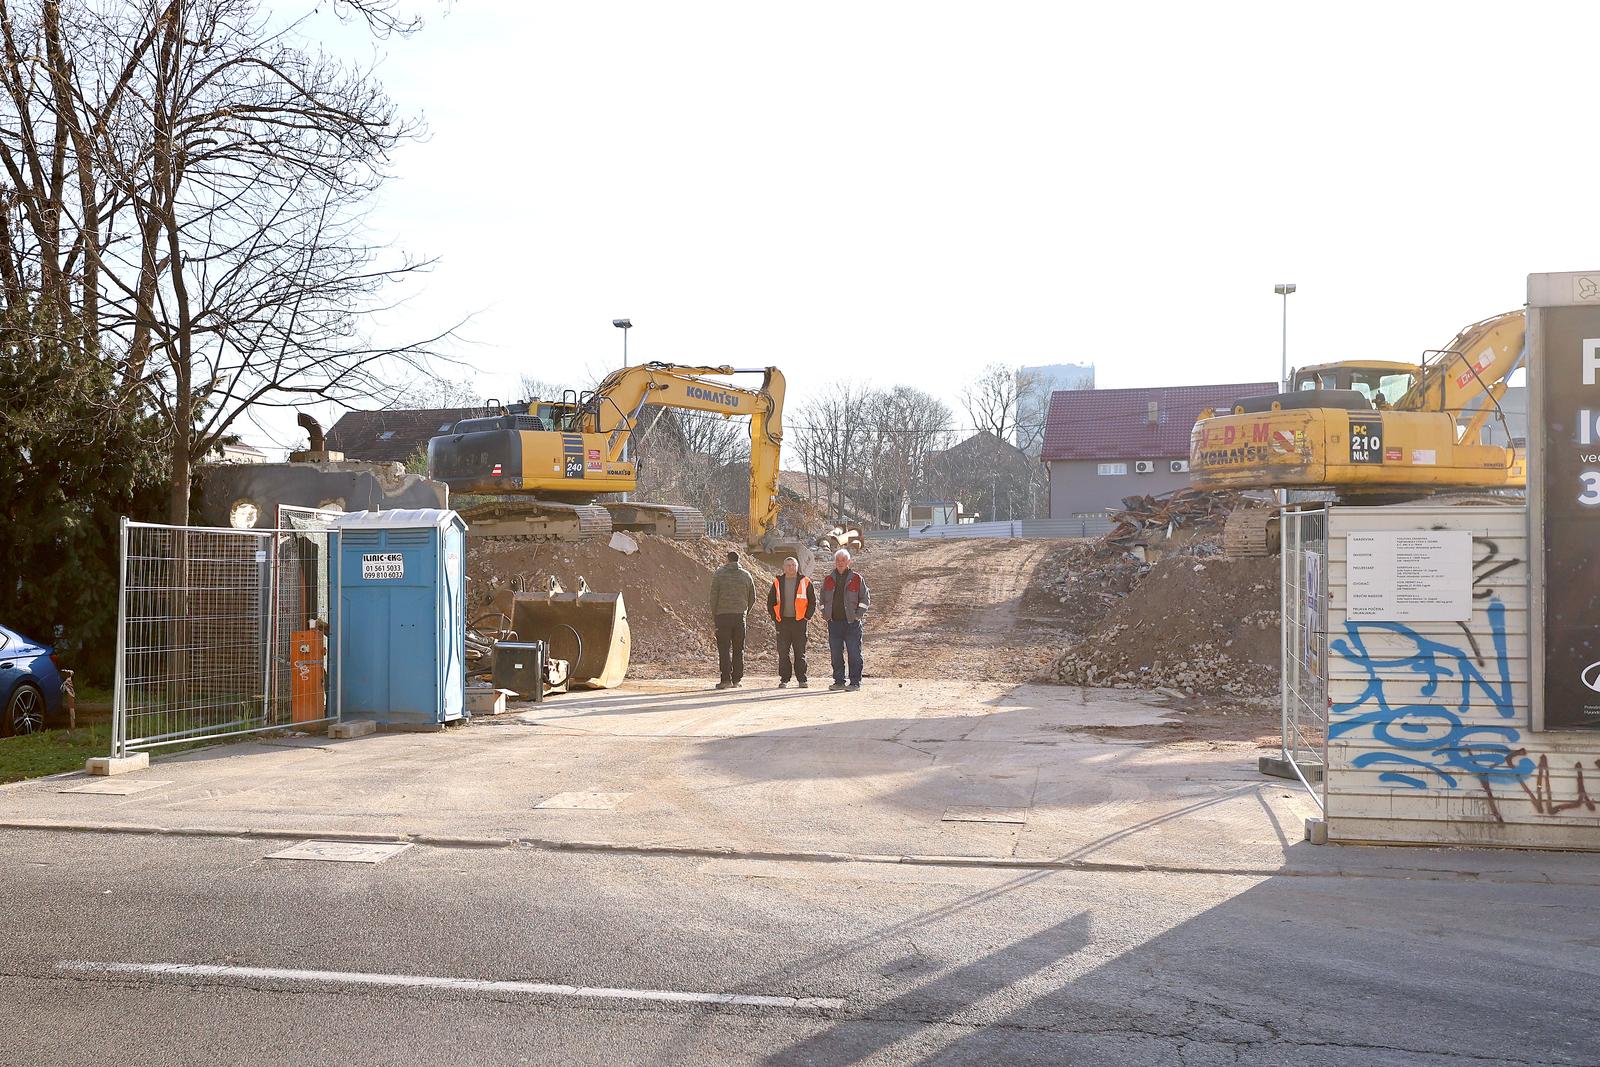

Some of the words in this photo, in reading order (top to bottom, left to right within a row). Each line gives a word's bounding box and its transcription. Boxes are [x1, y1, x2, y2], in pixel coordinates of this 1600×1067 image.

[687, 386, 739, 407] KOMATSU
[1353, 425, 1367, 435] PC
[1352, 436, 1380, 450] 210
[566, 463, 582, 472] 240
[607, 468, 631, 476] KOMATSU
